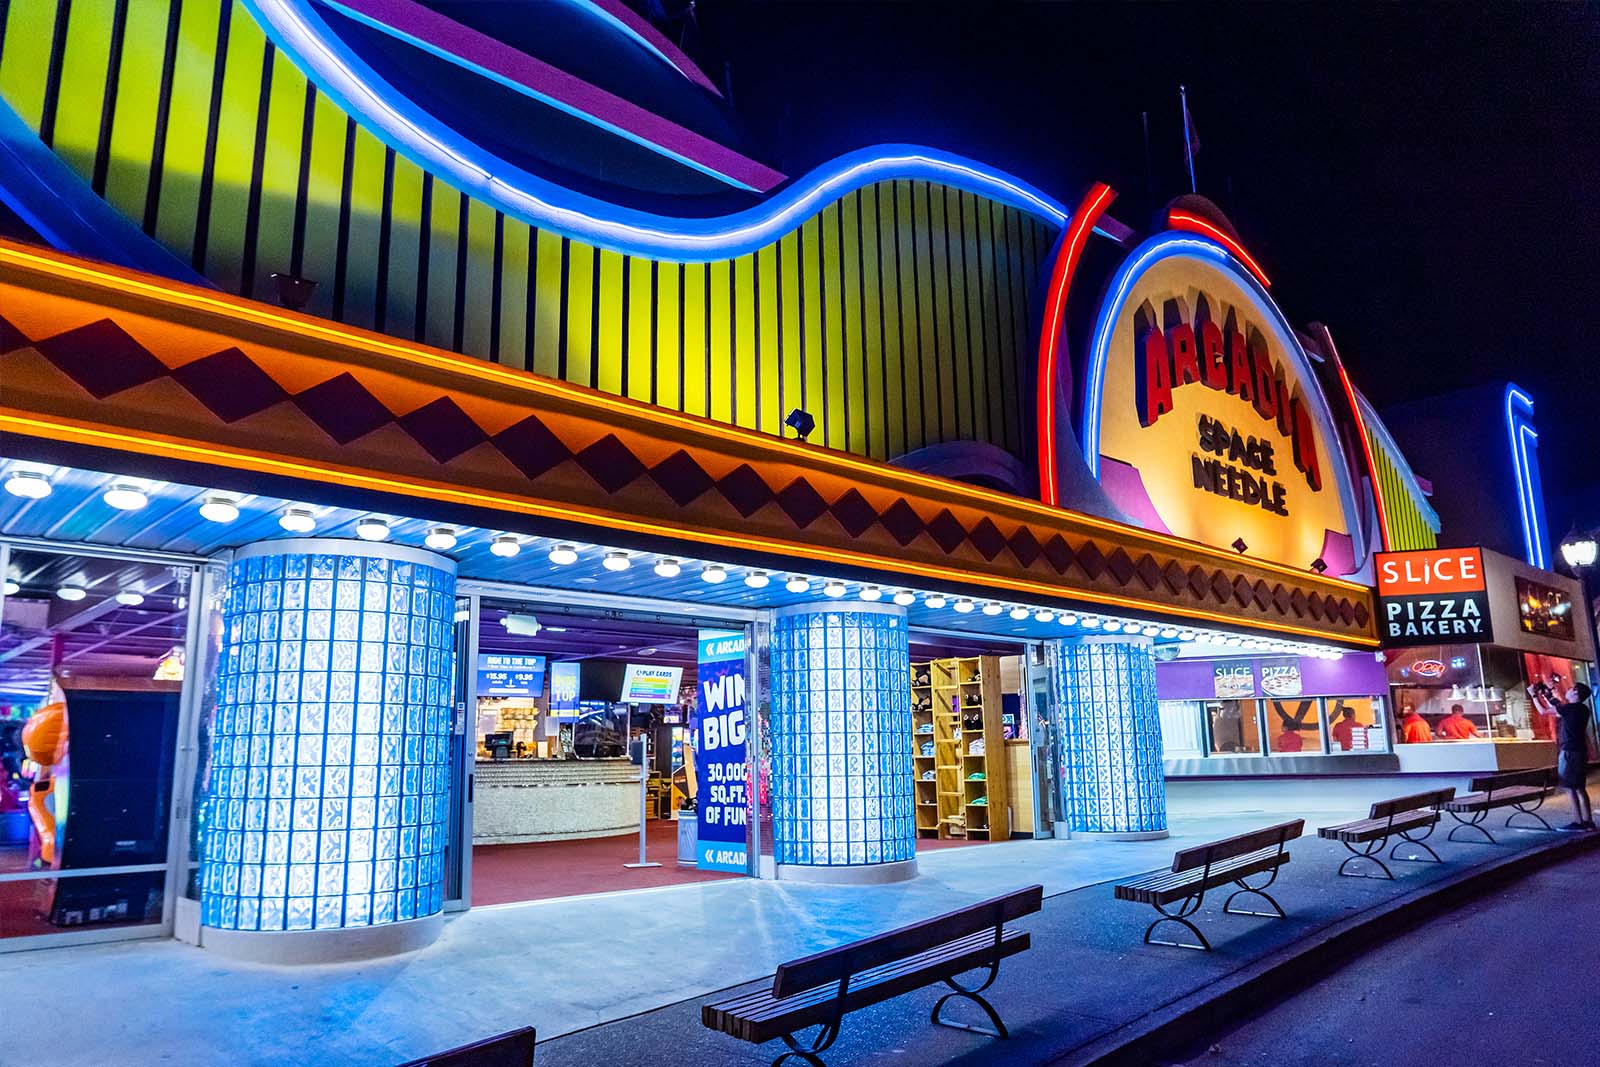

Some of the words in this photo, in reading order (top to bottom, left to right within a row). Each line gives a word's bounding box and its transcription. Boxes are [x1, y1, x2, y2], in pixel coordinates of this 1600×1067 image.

[1134, 300, 1322, 492] ARCADIA
[1199, 414, 1276, 476] SPACE
[1192, 453, 1289, 517] NEEDLE
[1386, 599, 1480, 621] PIZZA
[1215, 667, 1250, 679] SLICE
[1261, 665, 1298, 677] PIZZA
[703, 673, 746, 713] WIN
[703, 710, 746, 750] BIG
[706, 806, 721, 825] OF
[724, 806, 747, 826] FUN
